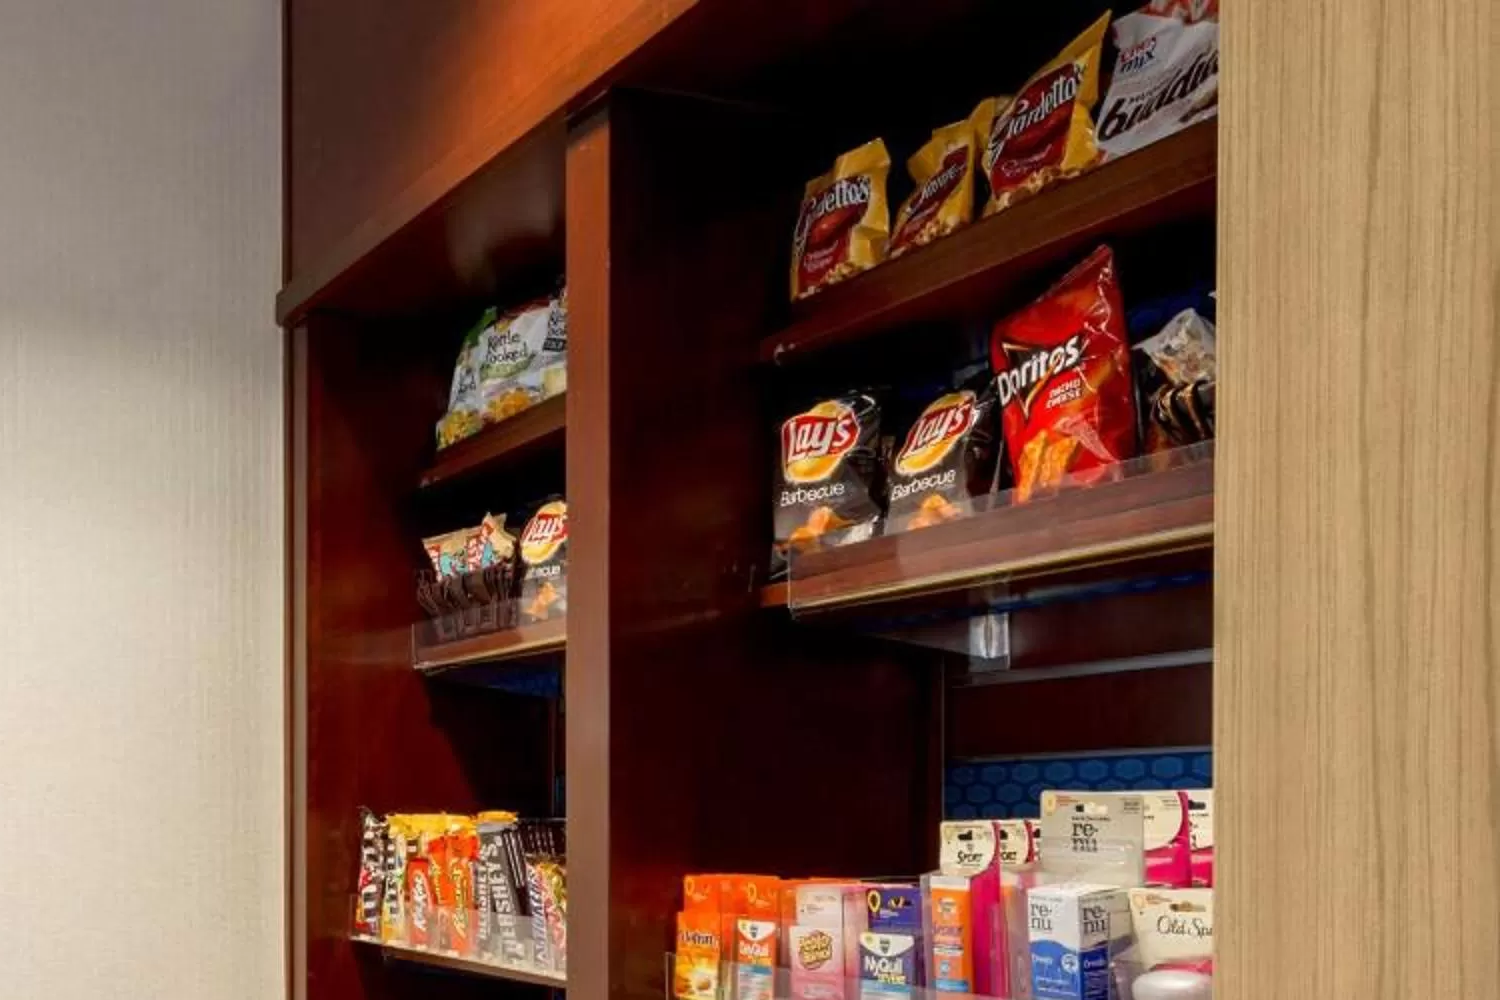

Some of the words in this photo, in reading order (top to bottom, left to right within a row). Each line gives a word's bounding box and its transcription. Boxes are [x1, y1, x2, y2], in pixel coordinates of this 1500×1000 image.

[997, 335, 1080, 406] Doritos
[787, 415, 852, 463] Lay's
[908, 402, 971, 456] Lay's
[780, 482, 846, 507] Barbecue
[891, 469, 957, 502] Barbecue
[1030, 918, 1053, 931] nu
[865, 956, 903, 976] NyQuil
